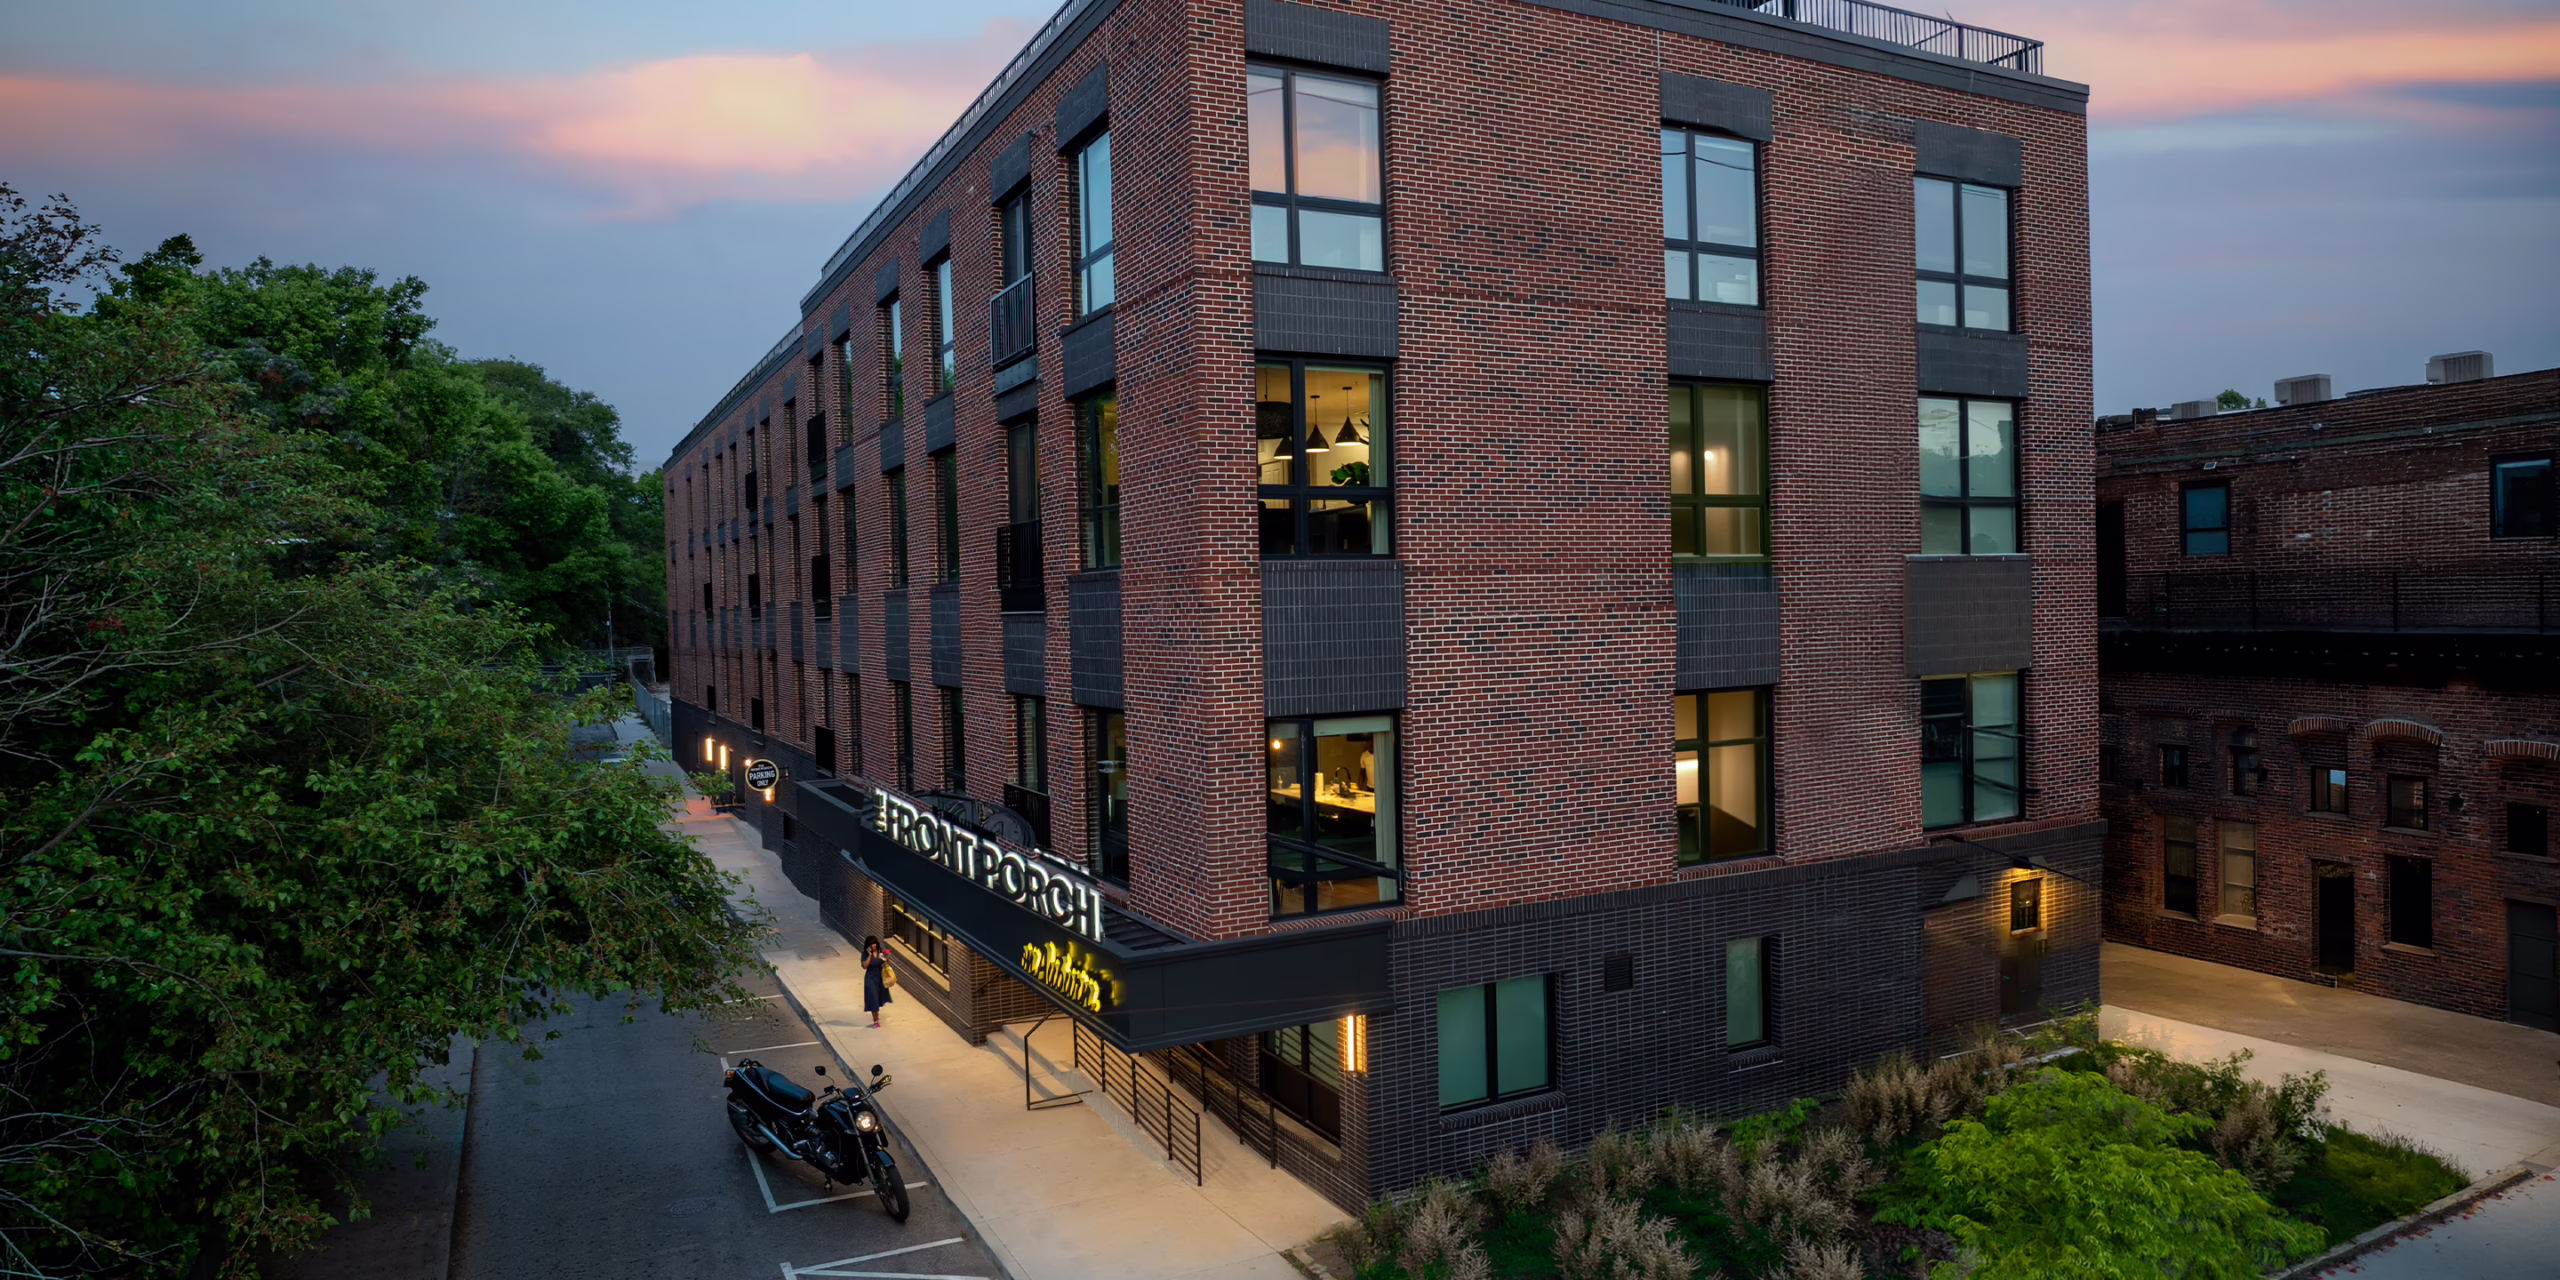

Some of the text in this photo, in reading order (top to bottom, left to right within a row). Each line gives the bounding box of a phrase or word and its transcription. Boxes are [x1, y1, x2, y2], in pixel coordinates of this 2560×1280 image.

[749, 770, 776, 780] PARKING
[887, 794, 1102, 943] FRONT PORCH
